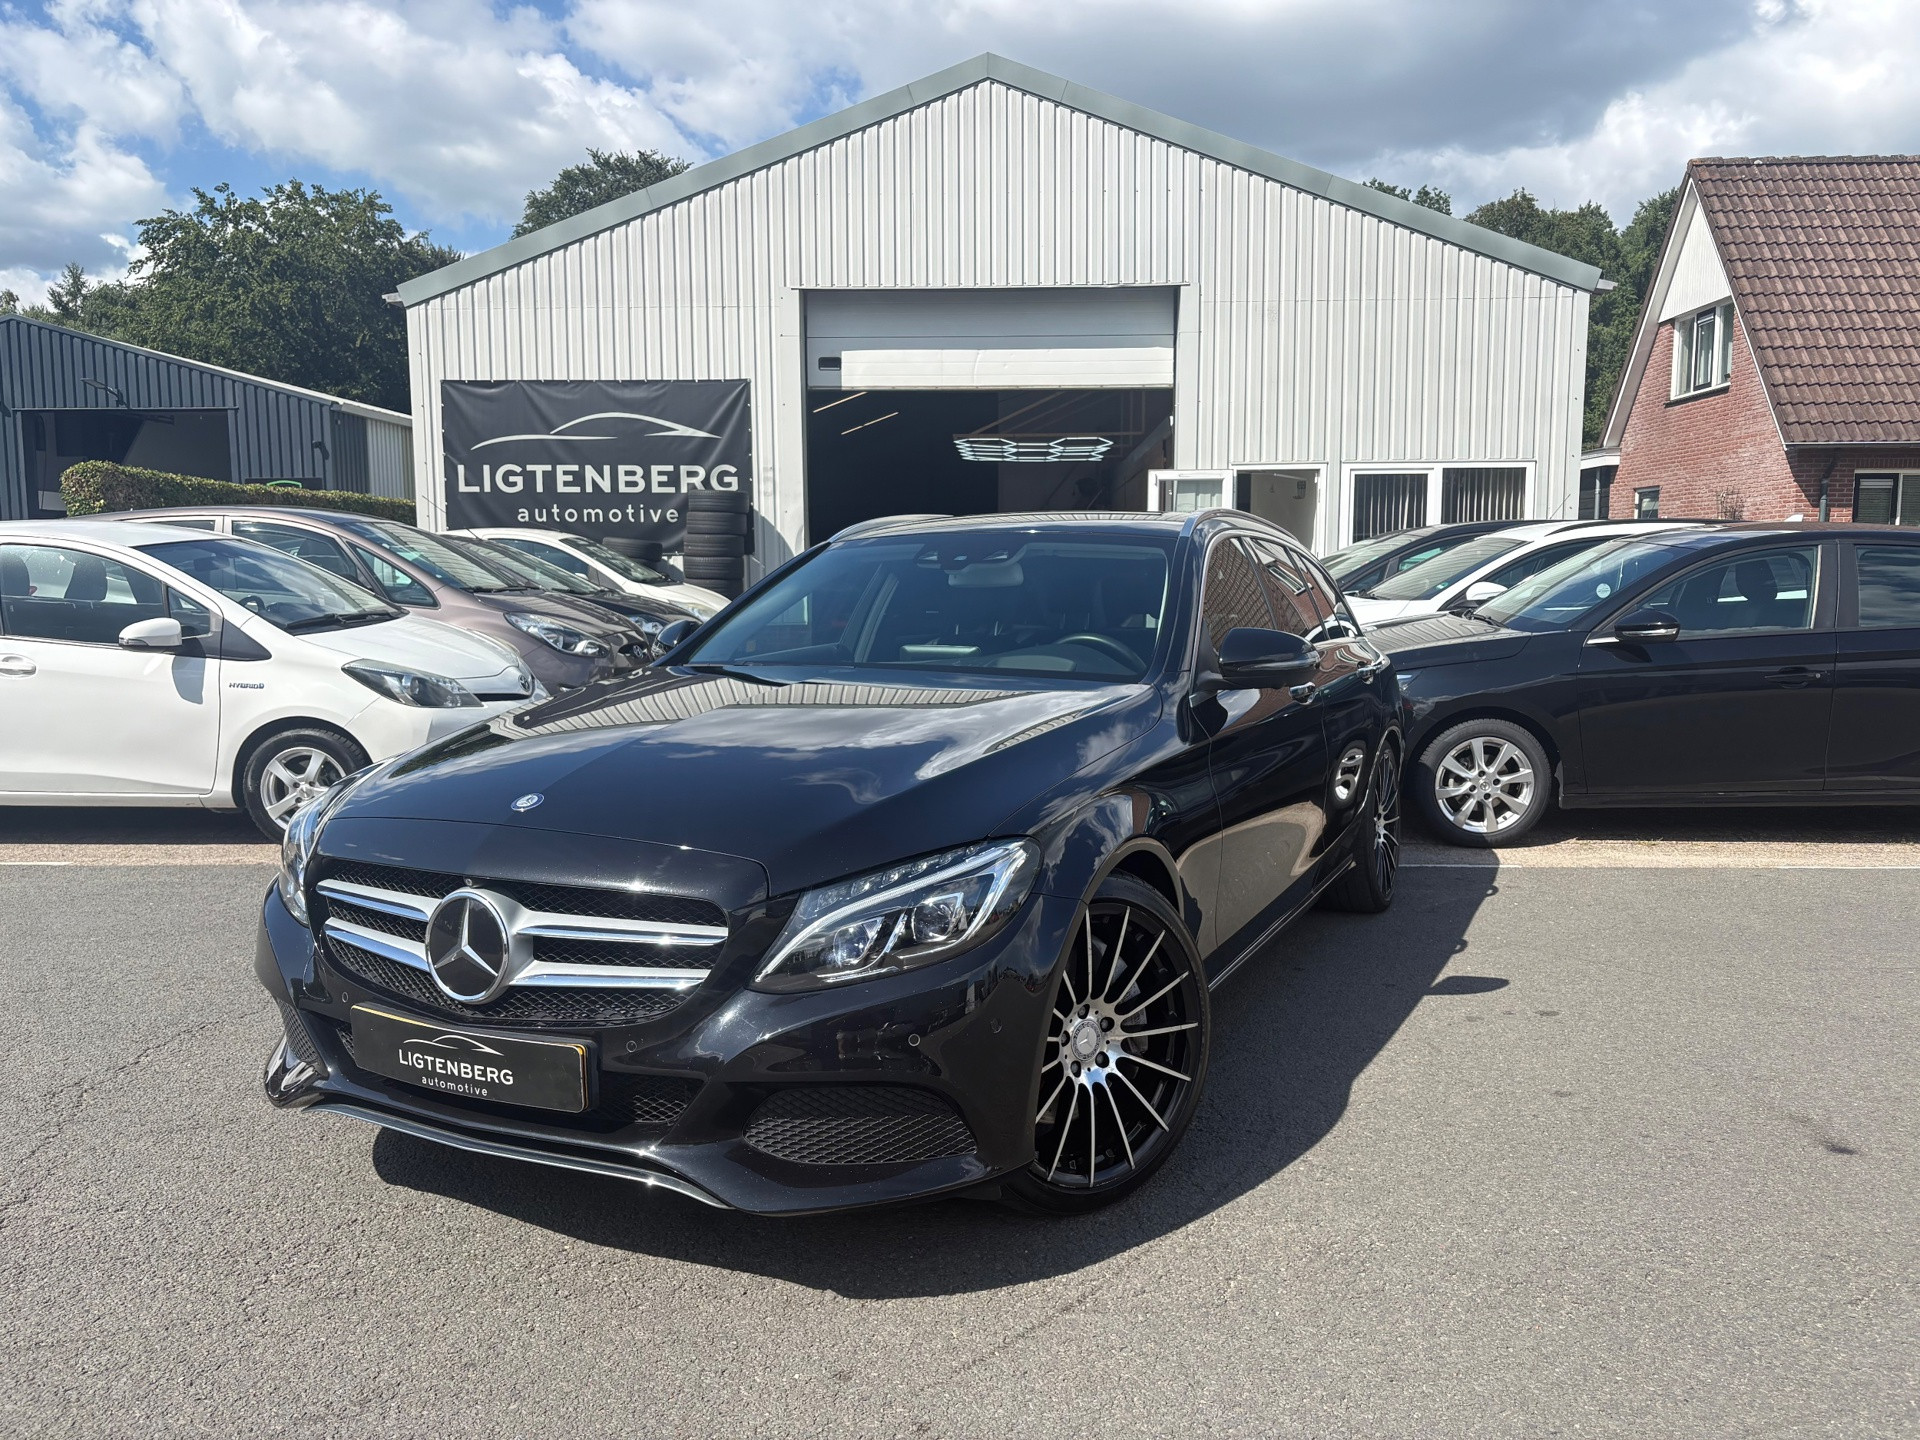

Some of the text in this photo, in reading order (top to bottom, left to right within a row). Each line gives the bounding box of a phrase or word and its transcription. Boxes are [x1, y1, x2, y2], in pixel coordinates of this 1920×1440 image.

[457, 464, 739, 493] LIGTENBERG
[517, 504, 679, 523] automotive
[399, 1049, 514, 1085] LIGTENBERG
[421, 1076, 488, 1096] automotive
